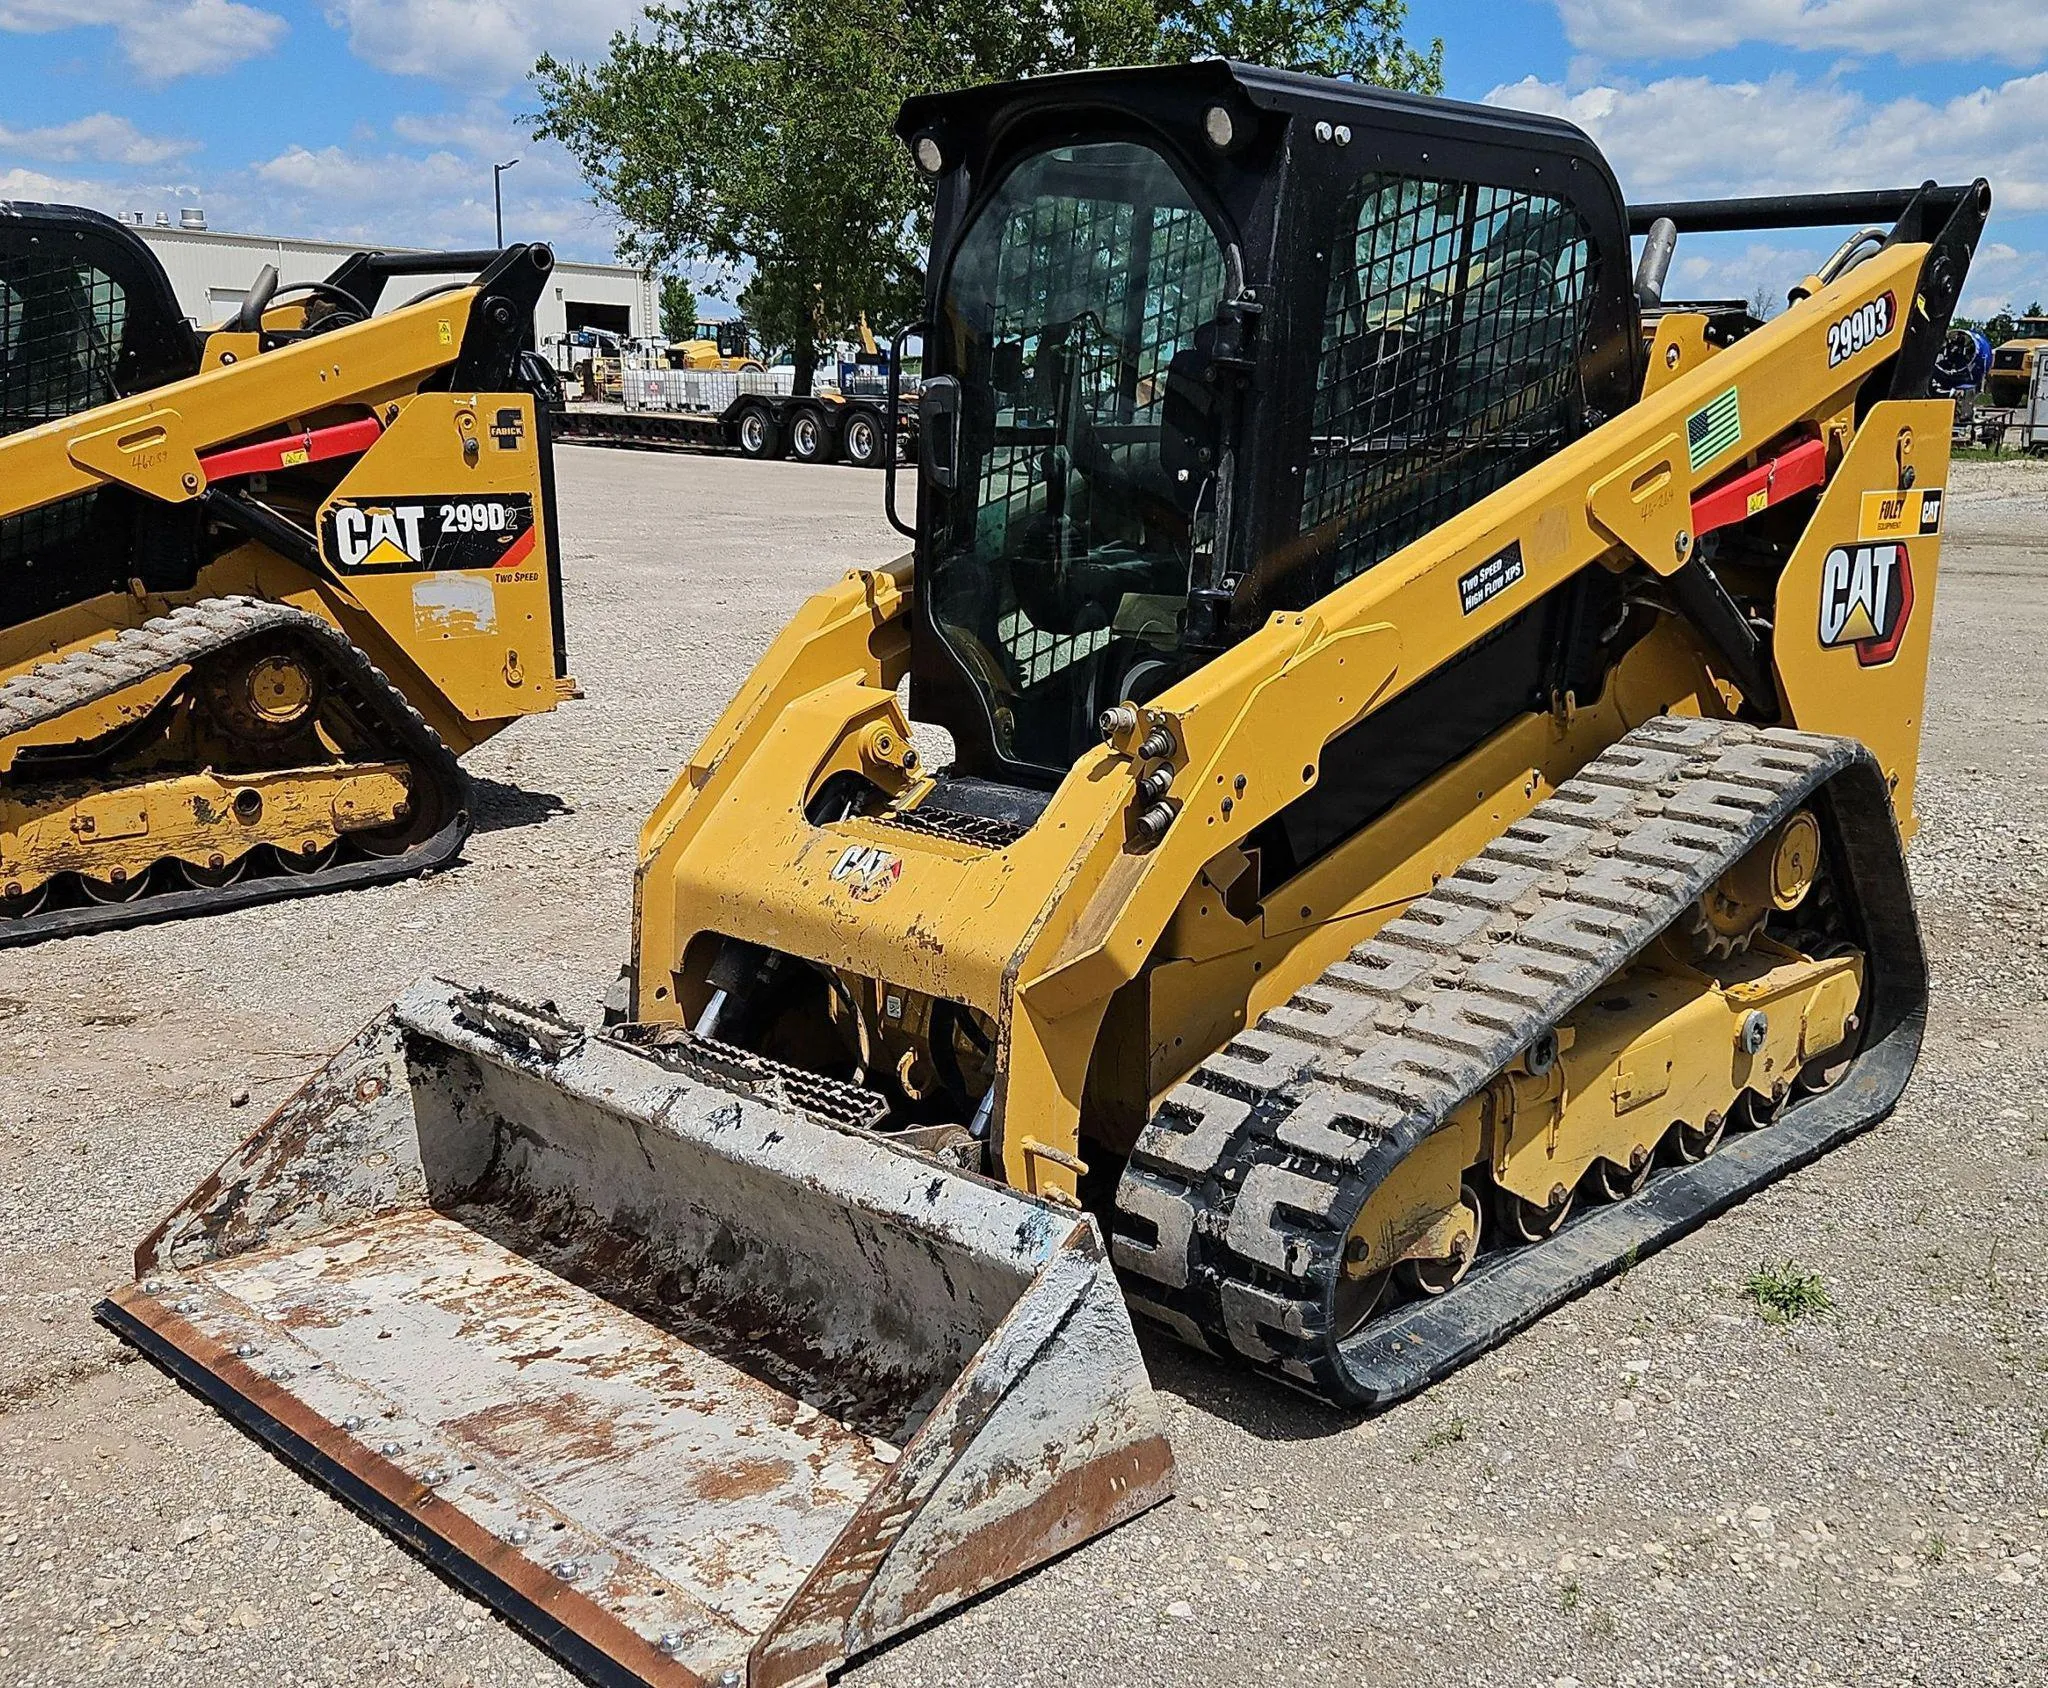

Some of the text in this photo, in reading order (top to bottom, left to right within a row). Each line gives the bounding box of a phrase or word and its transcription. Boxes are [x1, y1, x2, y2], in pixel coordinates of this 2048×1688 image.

[1828, 297, 1887, 366] 299D3
[491, 427, 522, 436] FABICK
[1879, 499, 1940, 523] FOLEY CAT
[335, 505, 425, 566] CAT
[1505, 561, 1521, 584] XPS
[1820, 545, 1897, 644] CAT
[831, 844, 893, 882] CAT
